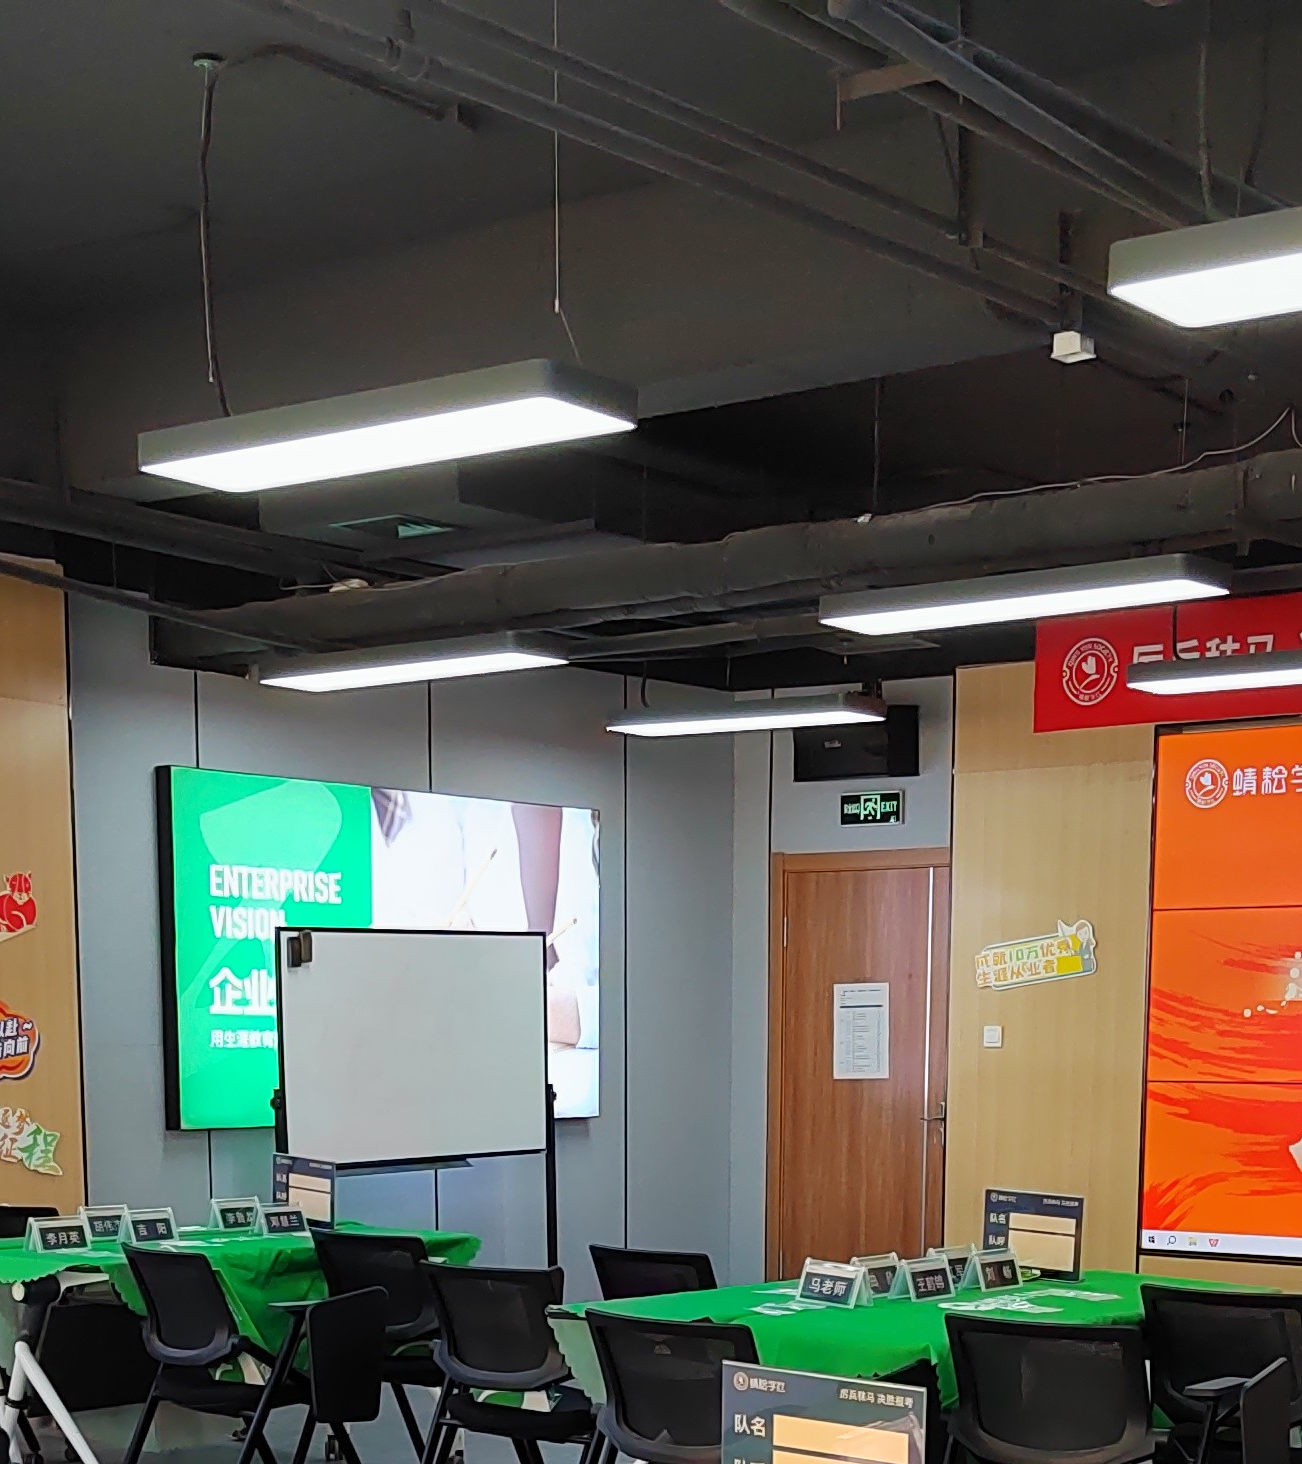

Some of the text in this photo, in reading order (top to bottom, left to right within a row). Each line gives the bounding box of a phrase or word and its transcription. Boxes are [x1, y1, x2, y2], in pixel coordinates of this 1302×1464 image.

[209, 864, 342, 904] ENTERPRISE
[209, 905, 286, 940] VISION
[734, 1413, 766, 1437] 队名
